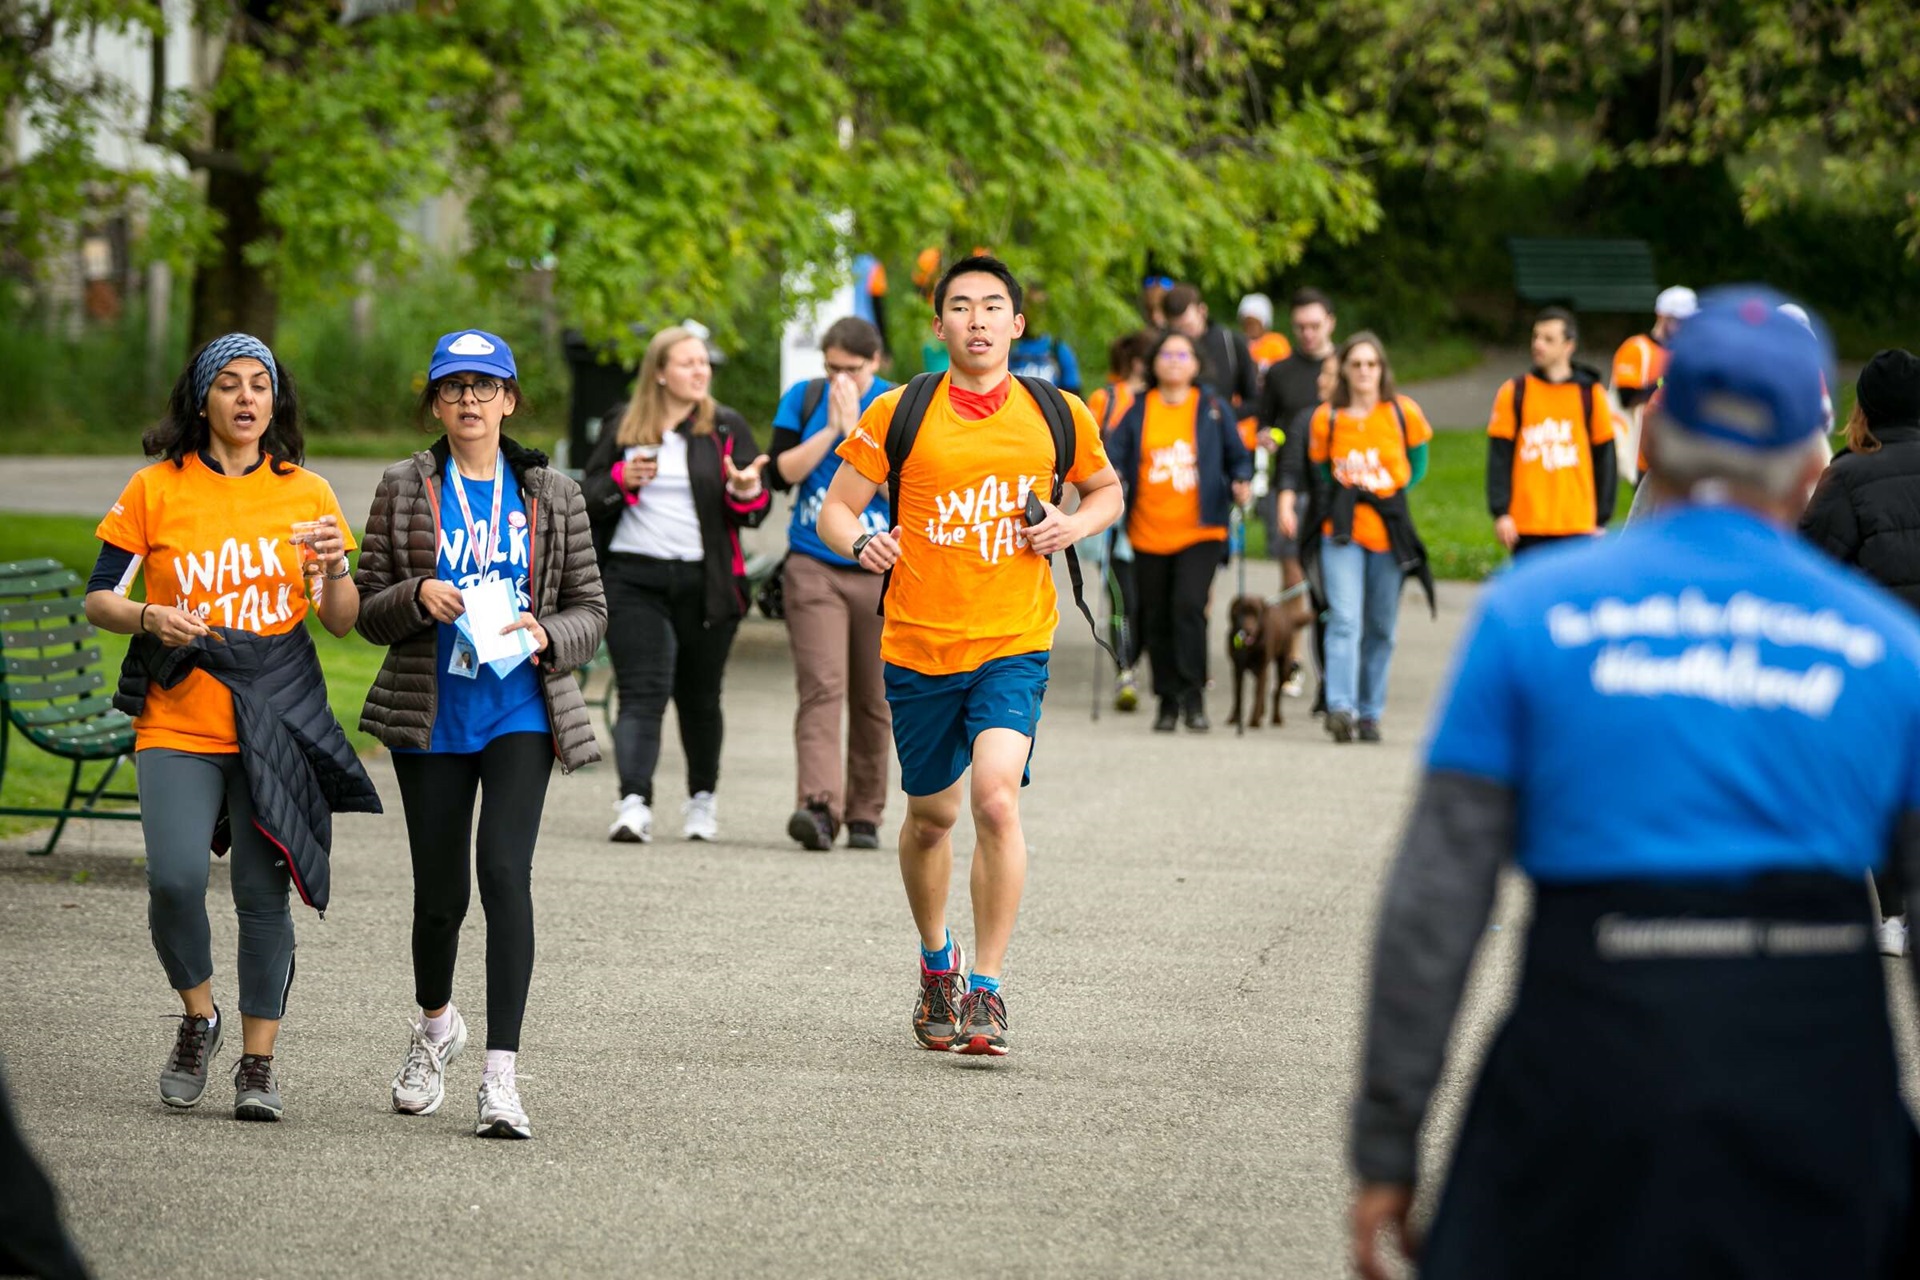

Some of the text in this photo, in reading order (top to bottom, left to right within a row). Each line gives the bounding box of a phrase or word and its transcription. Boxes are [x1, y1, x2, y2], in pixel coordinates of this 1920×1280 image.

[935, 475, 1037, 525] WALK
[925, 518, 967, 546] the
[971, 517, 1029, 564] TAL
[173, 536, 286, 595] WALK
[214, 583, 294, 632] TALK
